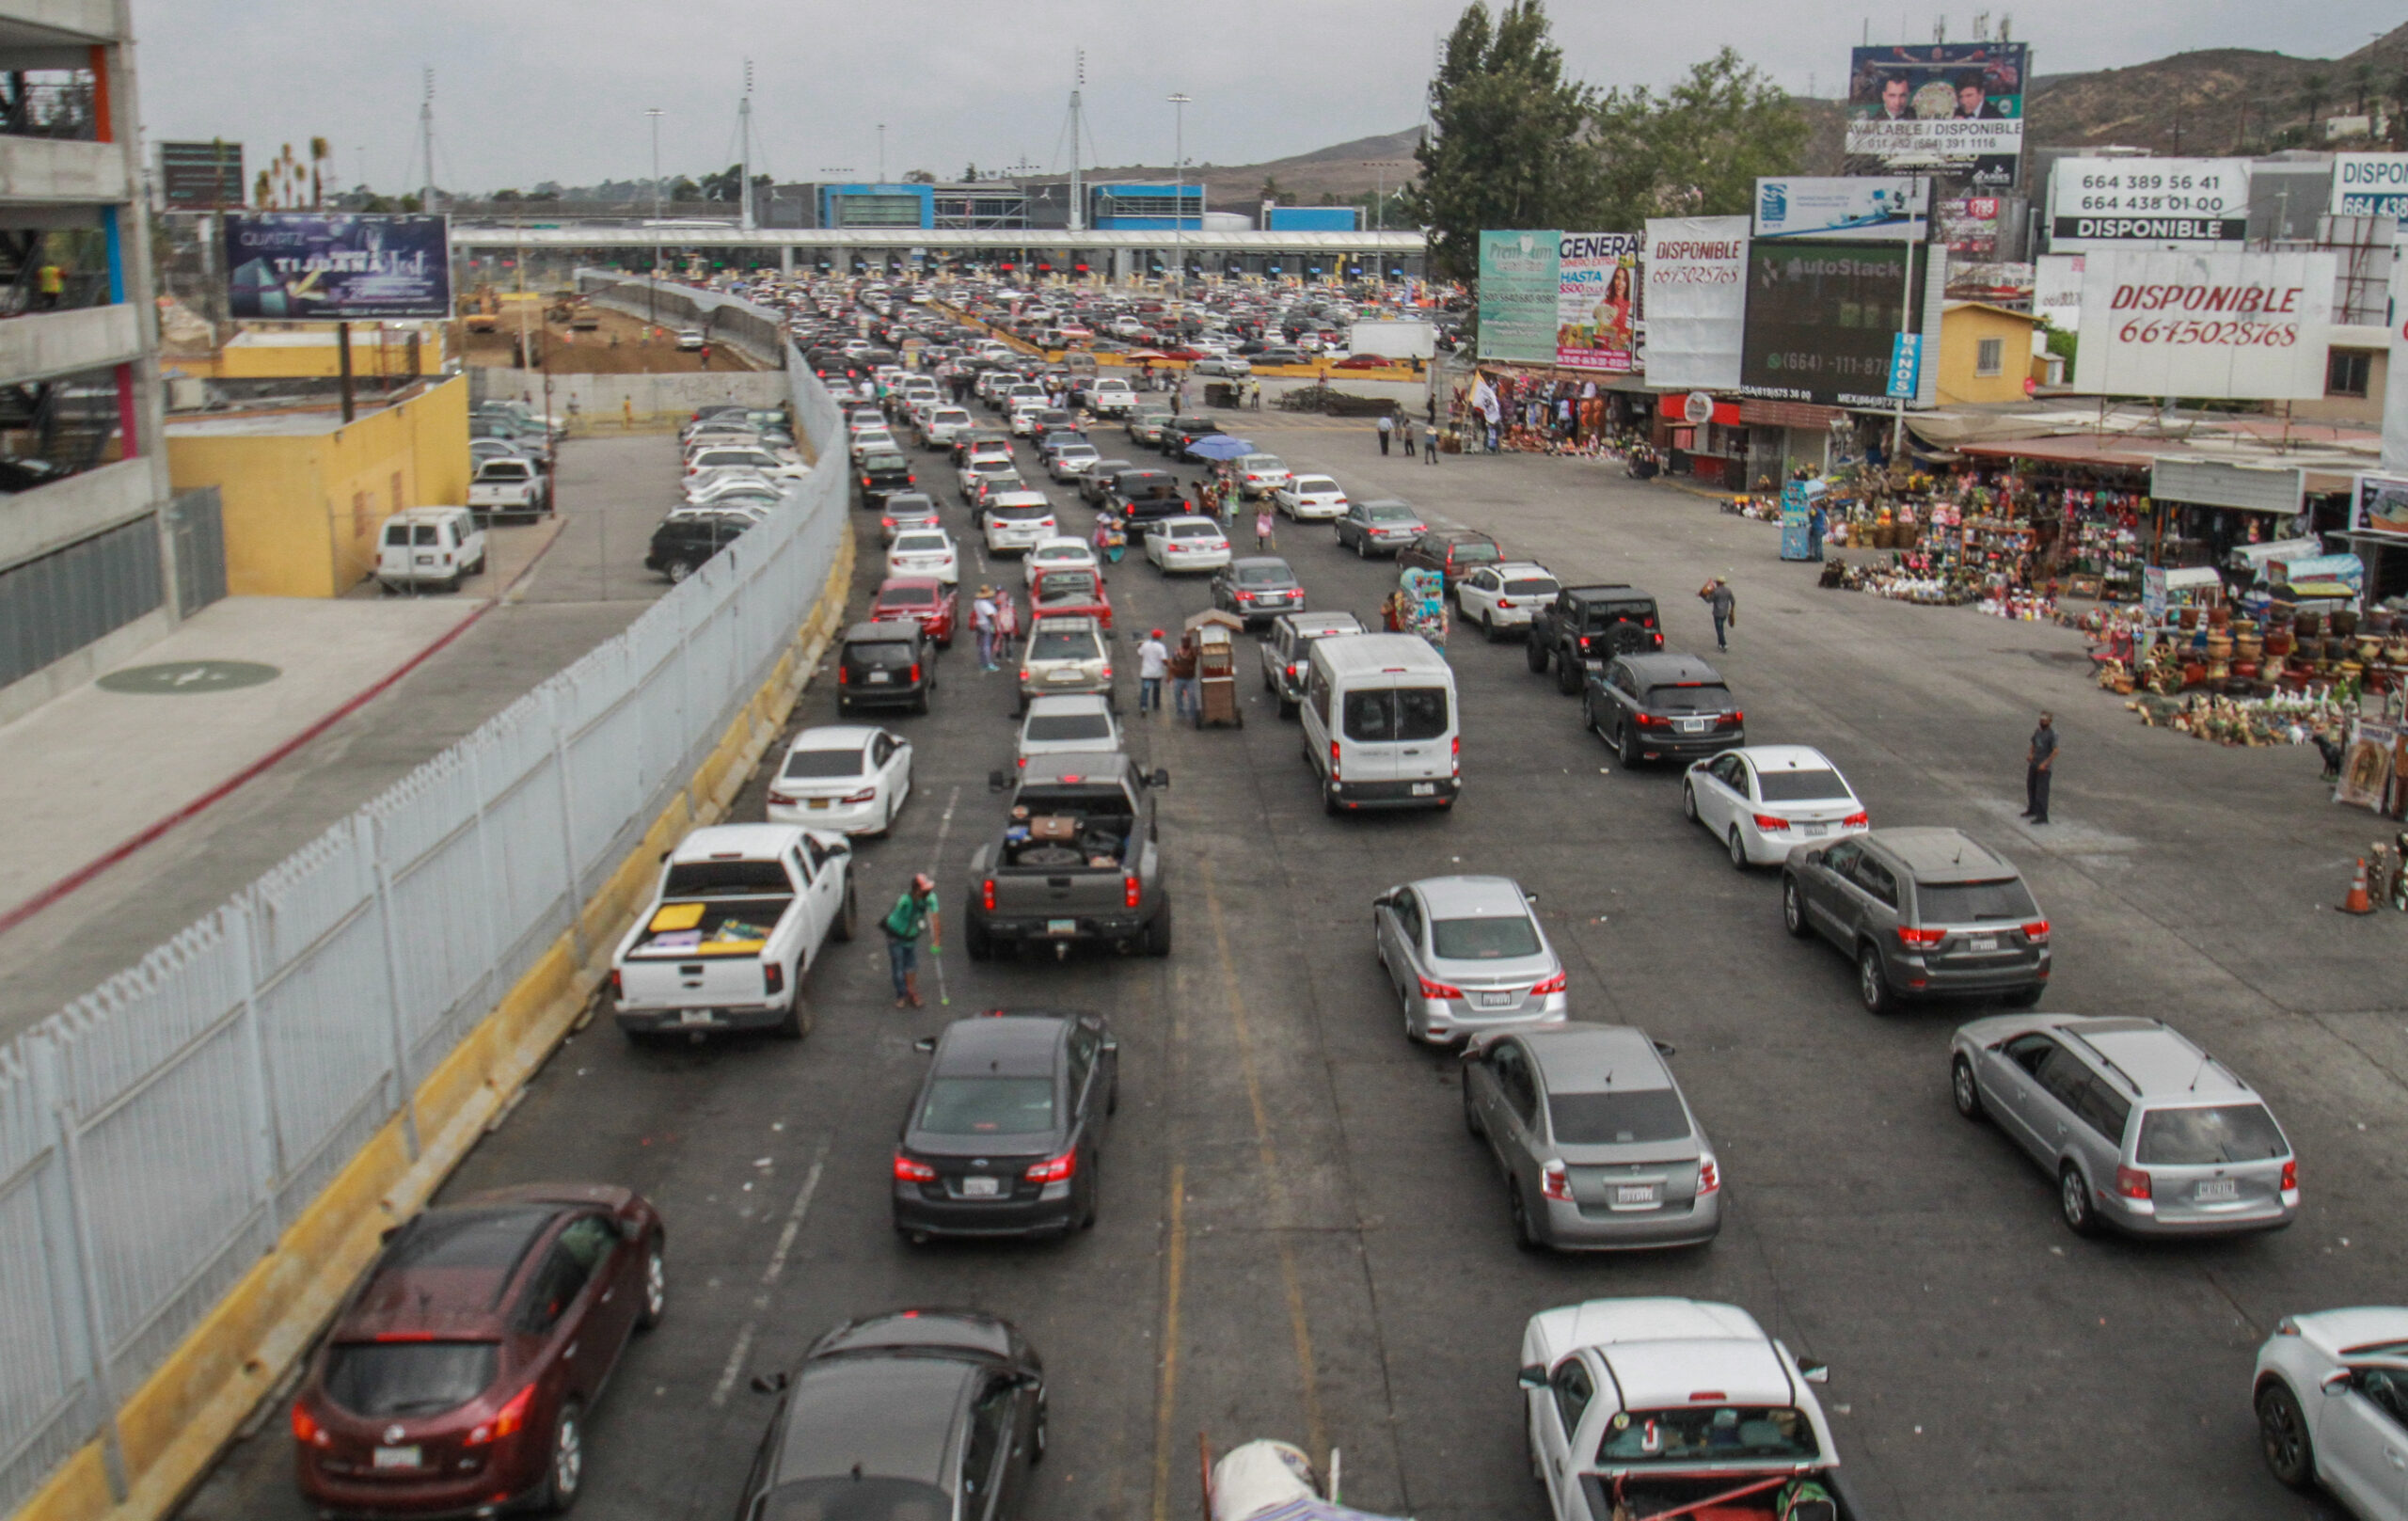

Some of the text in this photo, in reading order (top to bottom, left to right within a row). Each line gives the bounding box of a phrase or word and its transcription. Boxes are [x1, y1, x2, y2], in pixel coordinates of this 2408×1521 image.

[1848, 123, 1922, 135] AVAILABLE
[1935, 123, 2022, 135] DISPONIBLE
[1945, 138, 1965, 149] 391
[1971, 138, 1996, 148] 1116
[2082, 176, 2220, 189] 664 389 56 41
[2082, 197, 2223, 211] 664 438 01 00
[2343, 197, 2374, 215] 664
[2077, 219, 2223, 238] DISPONIBLE
[1560, 235, 1637, 259] GENERA
[1656, 241, 1742, 260] DISPONIBLE
[1560, 271, 1602, 282] HASTA
[1789, 258, 1901, 277] AutoStack
[2110, 285, 2304, 312] DISPONIBLE
[1782, 353, 1822, 372] (664)
